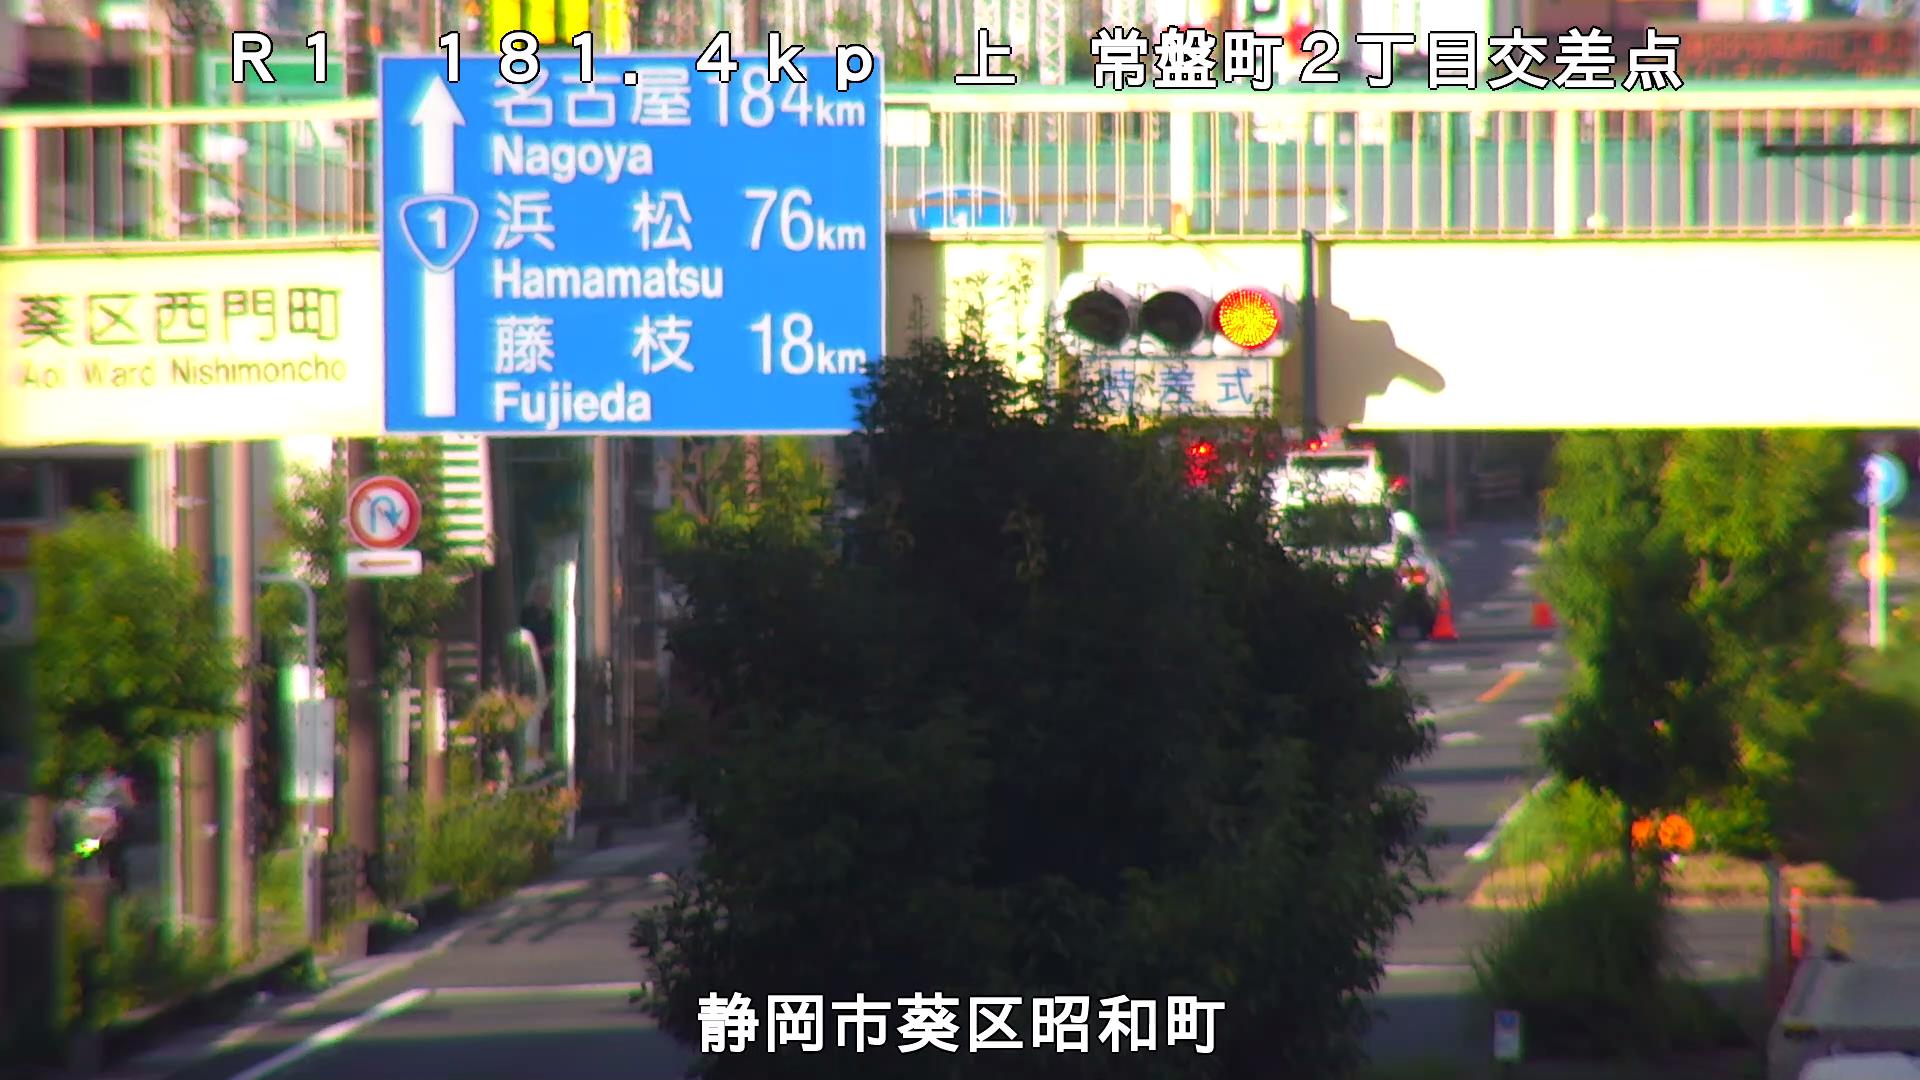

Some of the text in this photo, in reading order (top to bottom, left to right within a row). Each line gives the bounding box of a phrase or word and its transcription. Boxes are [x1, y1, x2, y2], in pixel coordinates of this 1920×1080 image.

[492, 63, 866, 128] 名古屋 184km
[492, 134, 654, 184] Nagoya
[427, 208, 447, 249] 1
[743, 189, 867, 251] 76km
[493, 257, 724, 299] Hamamatsu
[19, 287, 343, 348] 葵区西門町
[171, 353, 348, 386] Nishimoncho
[493, 380, 652, 430] Fujieda
